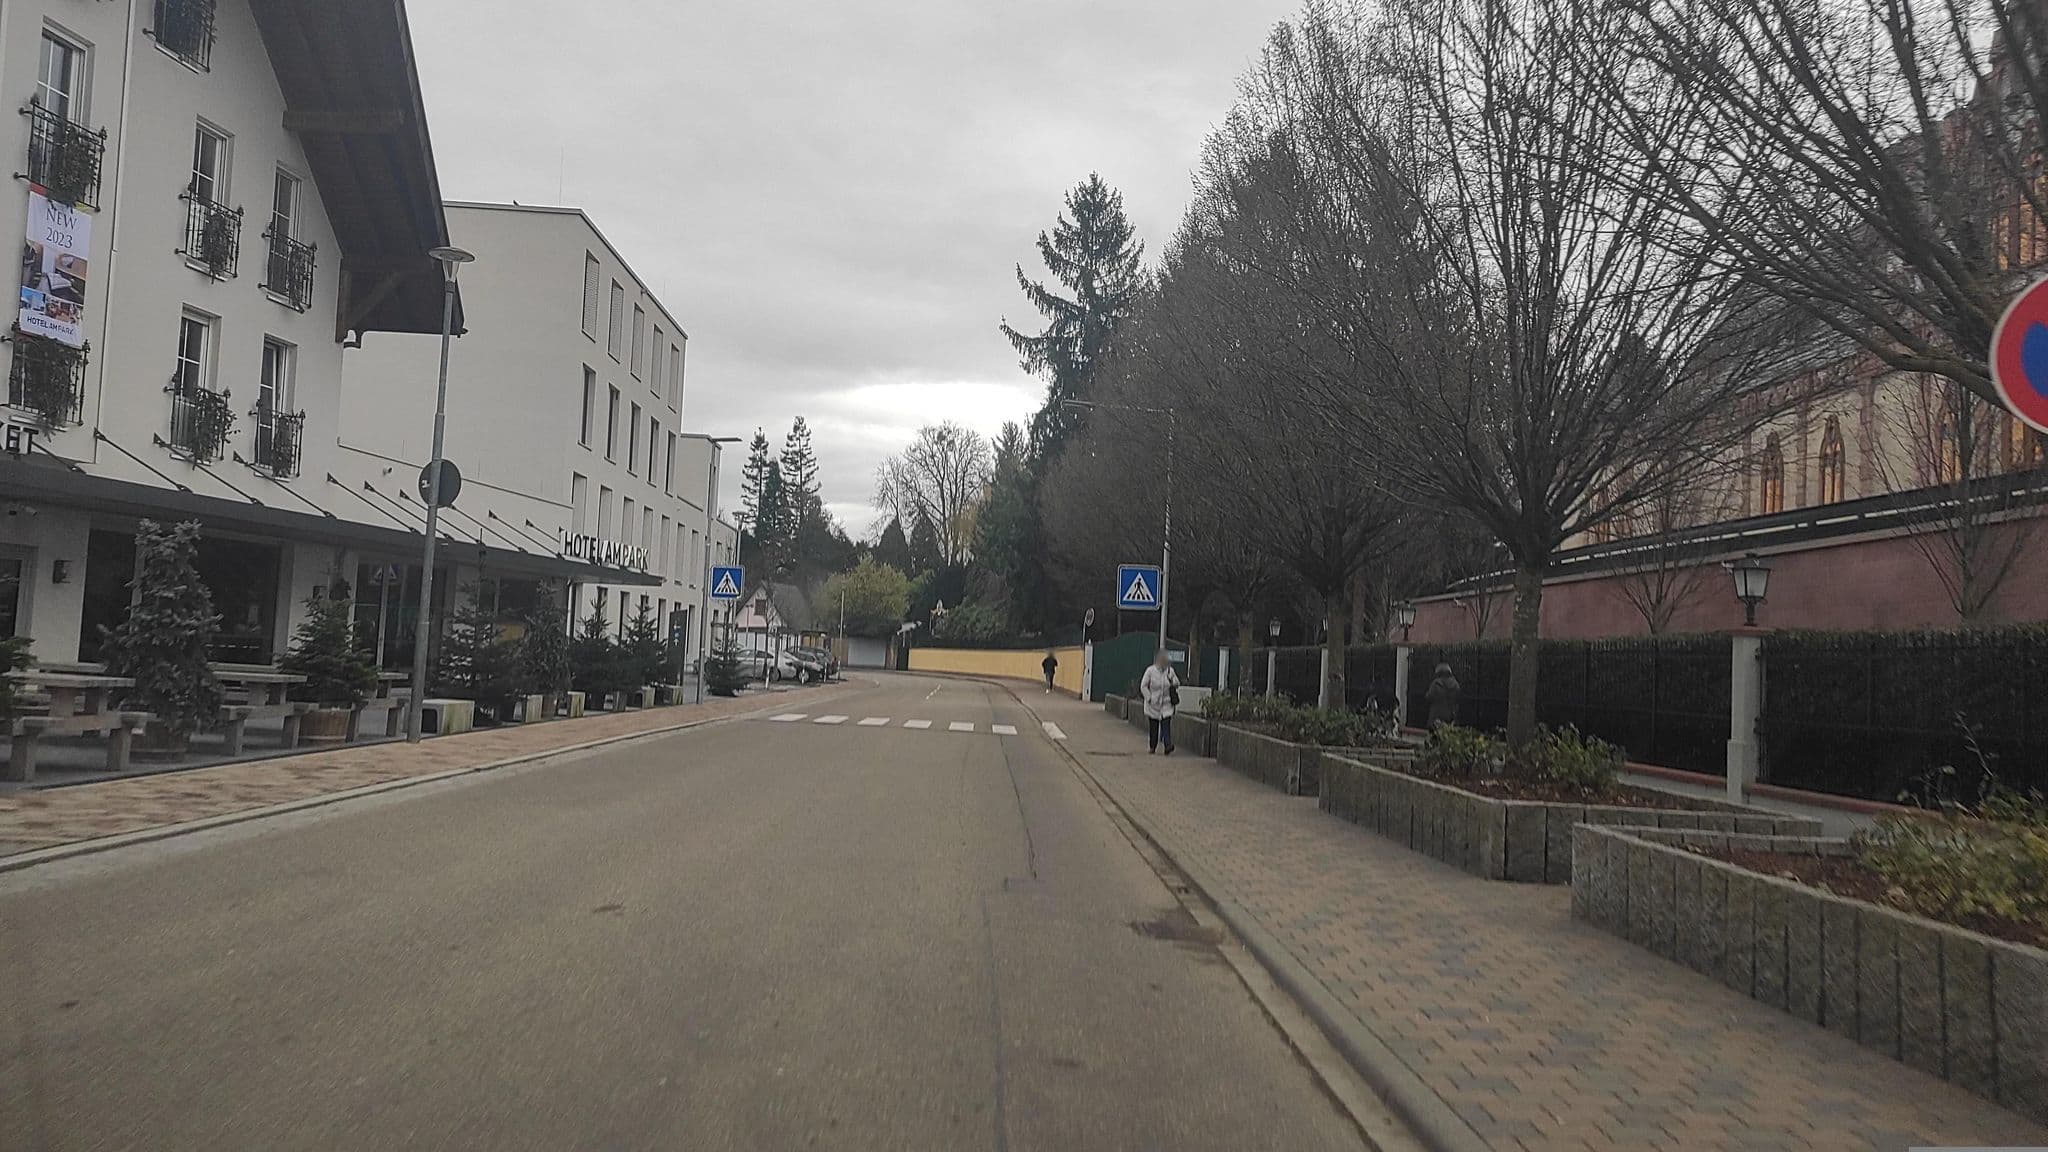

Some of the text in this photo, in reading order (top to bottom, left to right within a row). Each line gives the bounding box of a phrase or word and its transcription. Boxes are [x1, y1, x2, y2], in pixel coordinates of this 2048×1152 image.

[46, 208, 78, 230] NEW
[46, 227, 73, 249] 2023
[0, 422, 39, 455] ET
